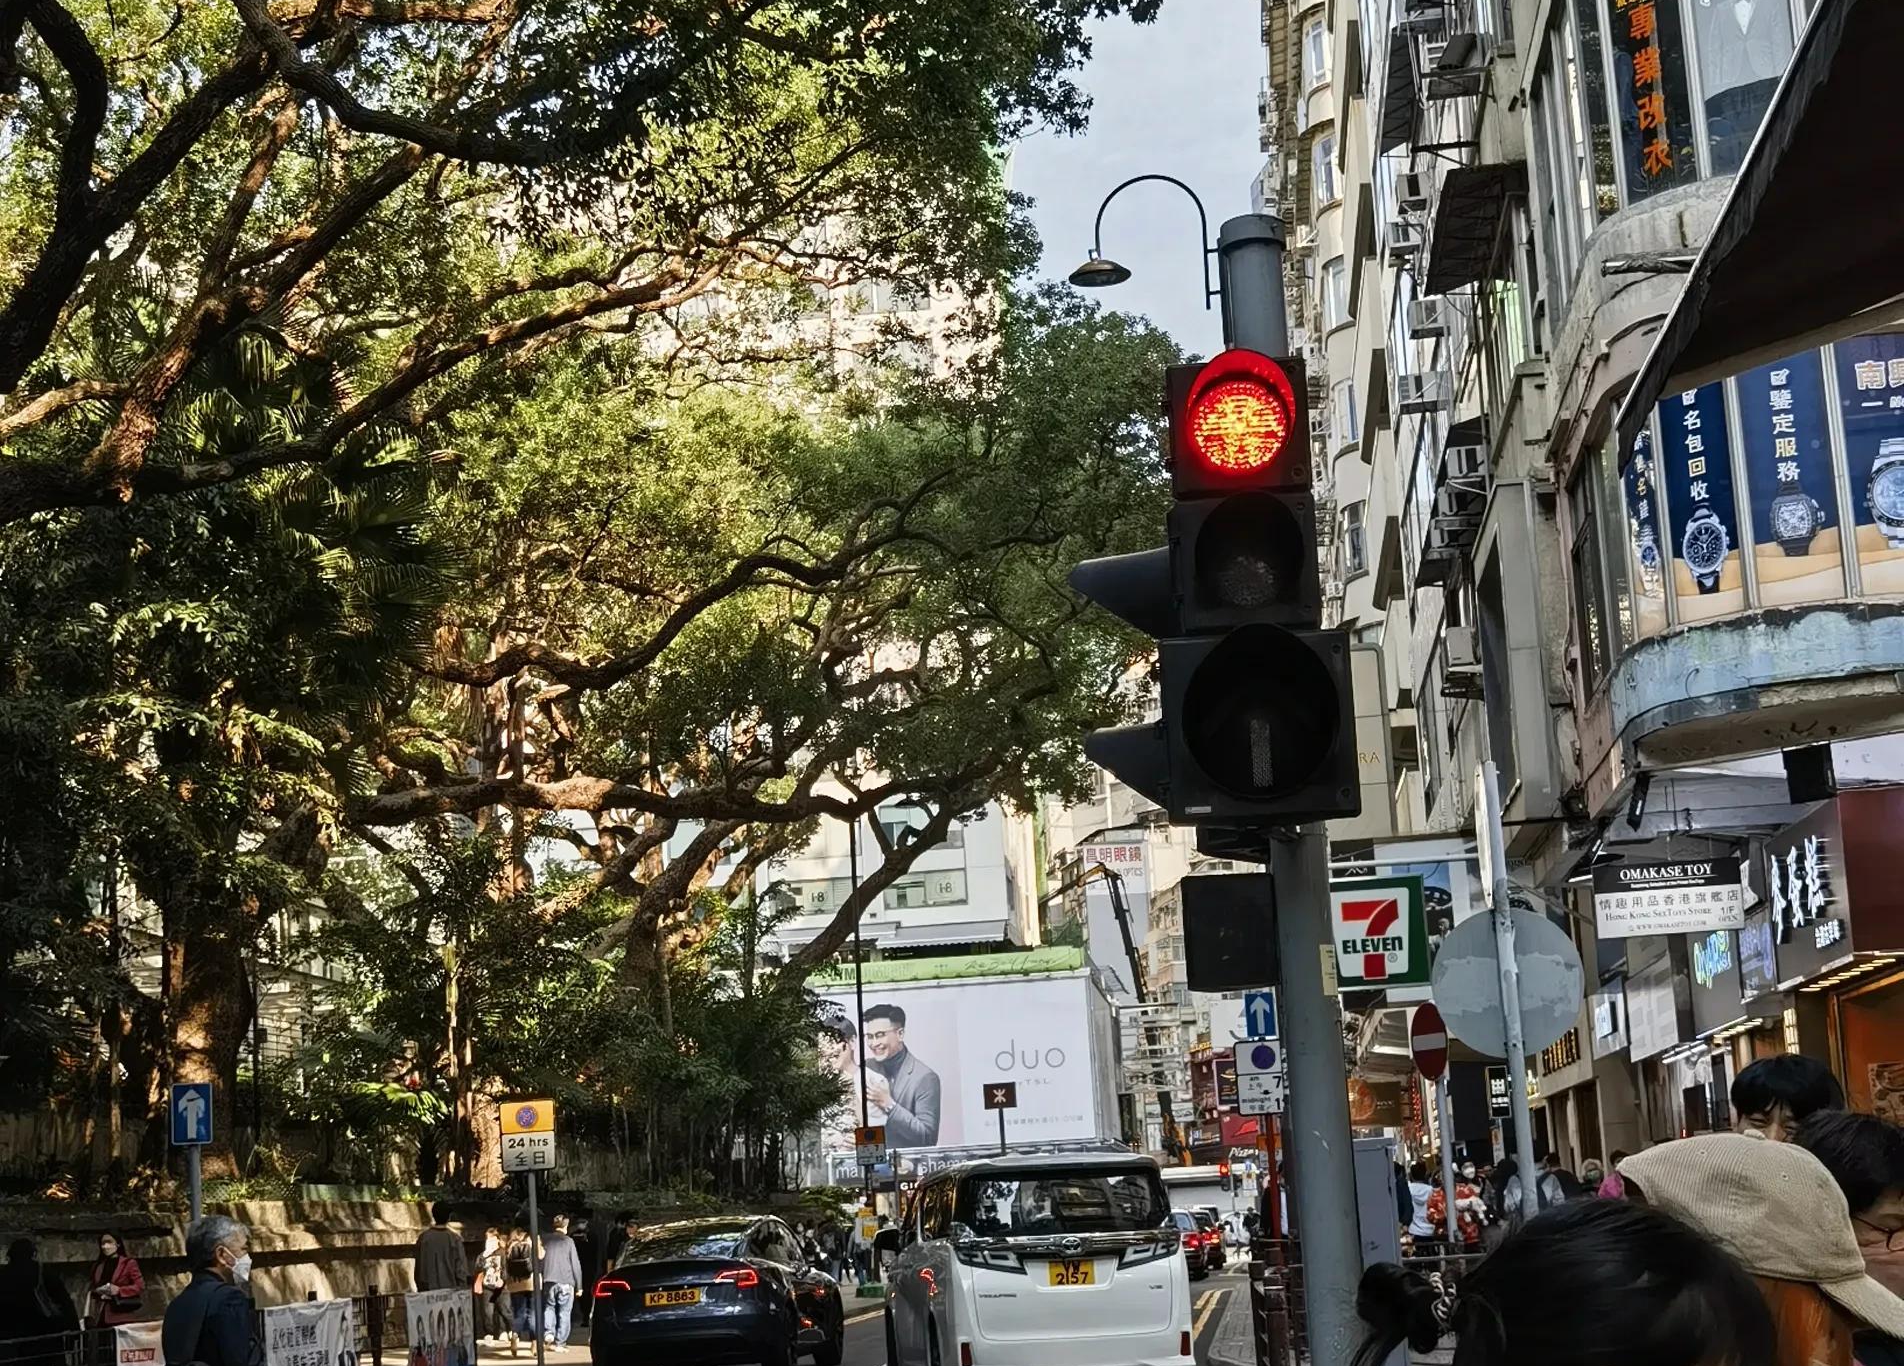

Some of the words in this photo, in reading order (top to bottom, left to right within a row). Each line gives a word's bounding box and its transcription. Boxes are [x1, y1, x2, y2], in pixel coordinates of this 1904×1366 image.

[1682, 410, 1710, 501] 名包回收
[1086, 846, 1142, 863] 昌明眼鏡
[1620, 866, 1683, 881] OMAKASE
[1684, 862, 1712, 876] TOY
[1341, 898, 1399, 978] 7
[995, 1039, 1065, 1071] duo
[1272, 1076, 1281, 1089] 7
[508, 1138, 525, 1149] 24
[529, 1137, 549, 1147] hrs
[515, 1151, 546, 1167] 全日
[650, 1294, 665, 1304] KP
